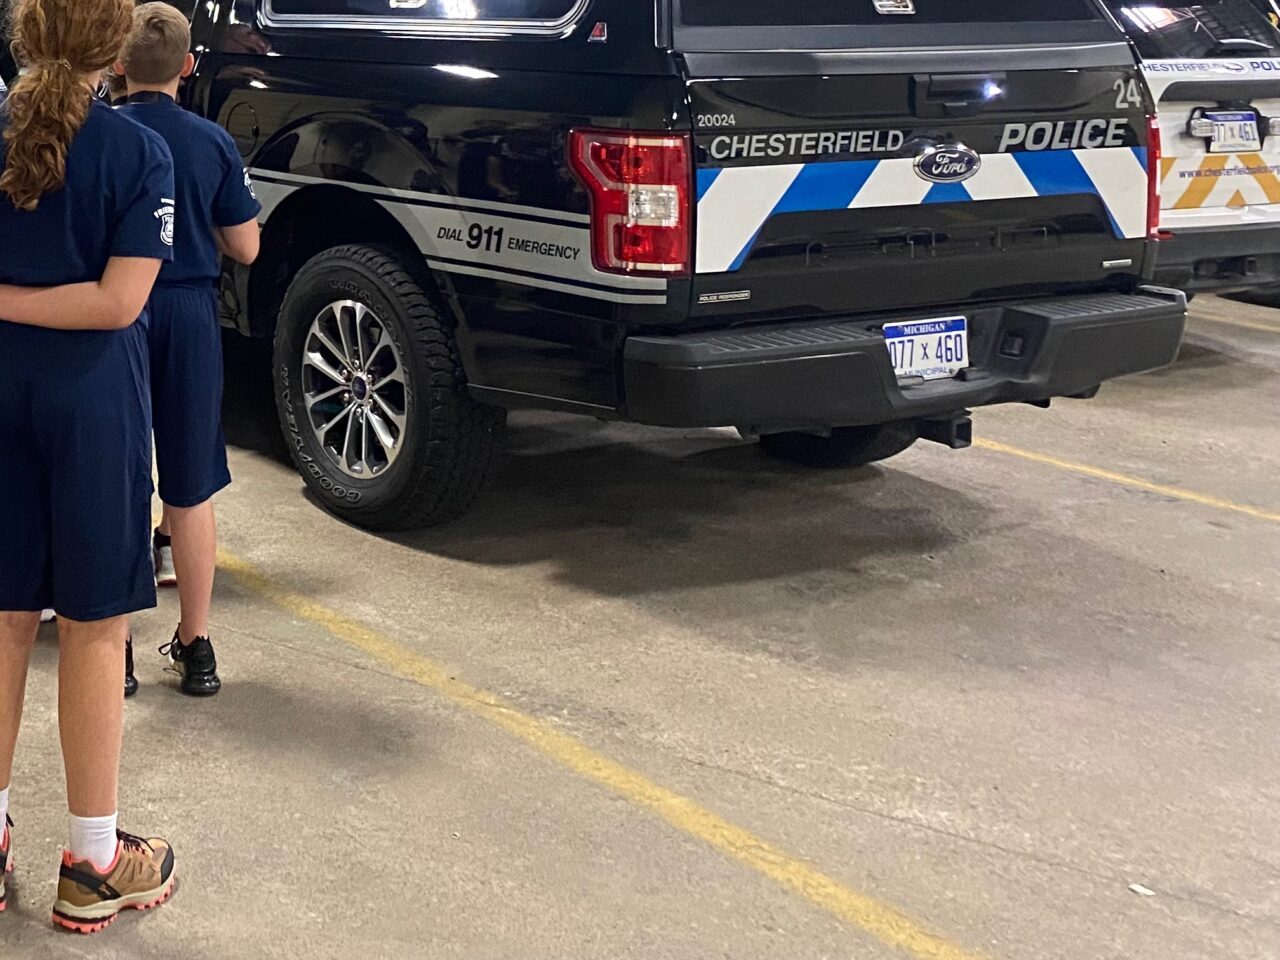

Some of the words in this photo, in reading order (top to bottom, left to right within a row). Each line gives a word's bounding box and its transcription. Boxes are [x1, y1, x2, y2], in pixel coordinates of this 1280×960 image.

[1143, 62, 1222, 72] HESTERFIELD
[1113, 78, 1141, 109] 24
[697, 114, 736, 127] 20024
[998, 118, 1128, 152] POLICE
[710, 130, 904, 159] CHESTERFIELD
[931, 152, 968, 175] Ford
[437, 227, 463, 242] DIAL
[466, 223, 504, 253] 911
[507, 237, 581, 260] EMERGENCY
[903, 322, 946, 335] MICHIGAN
[889, 339, 914, 369] 077
[935, 334, 963, 363] 460
